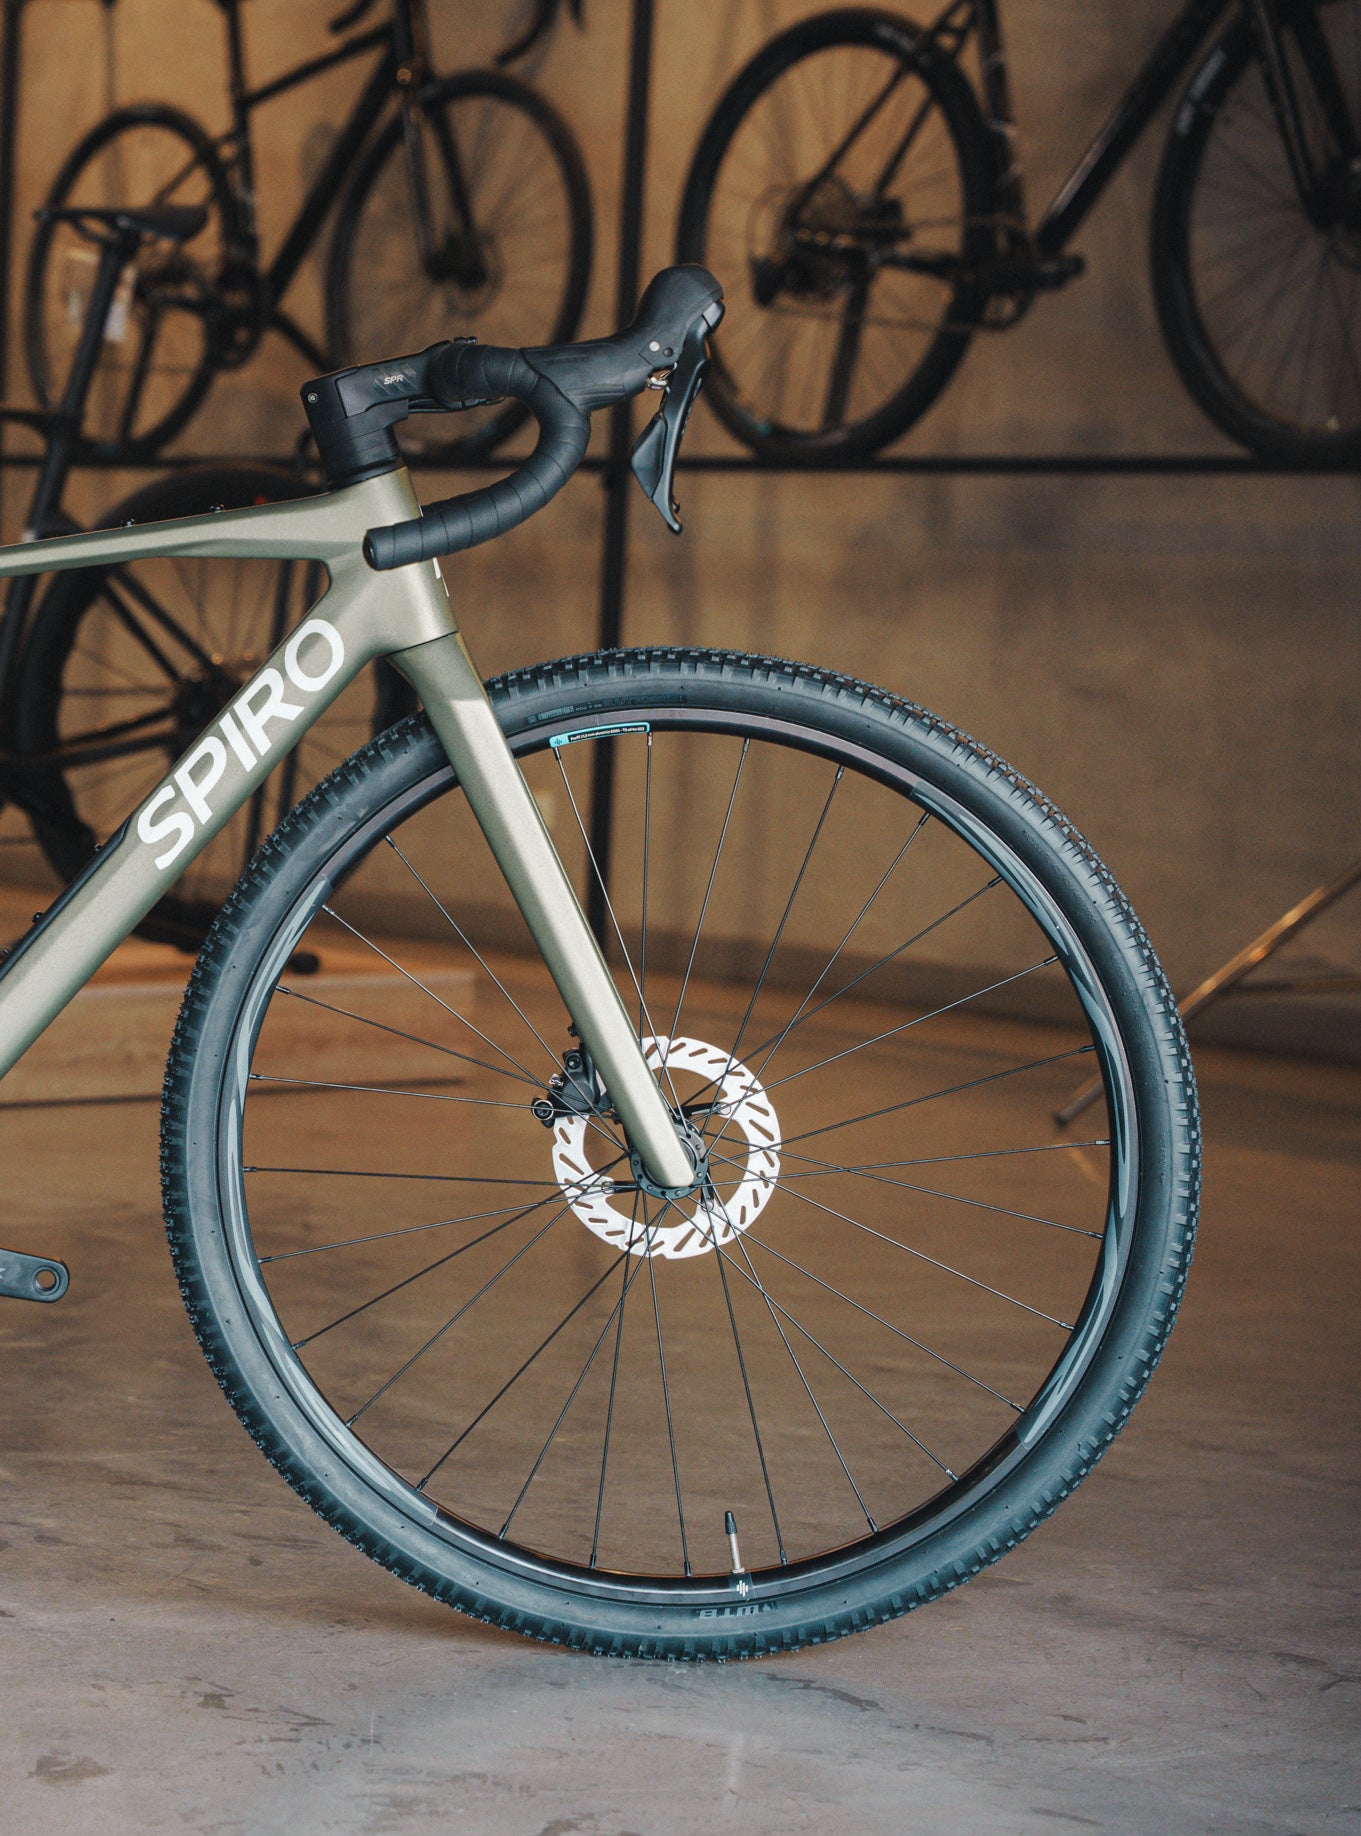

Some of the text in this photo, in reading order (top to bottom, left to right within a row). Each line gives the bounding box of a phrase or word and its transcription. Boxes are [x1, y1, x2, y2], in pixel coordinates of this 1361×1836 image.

[383, 374, 404, 385] SPR
[136, 618, 345, 870] SPIRO
[700, 1604, 759, 1618] WTB
